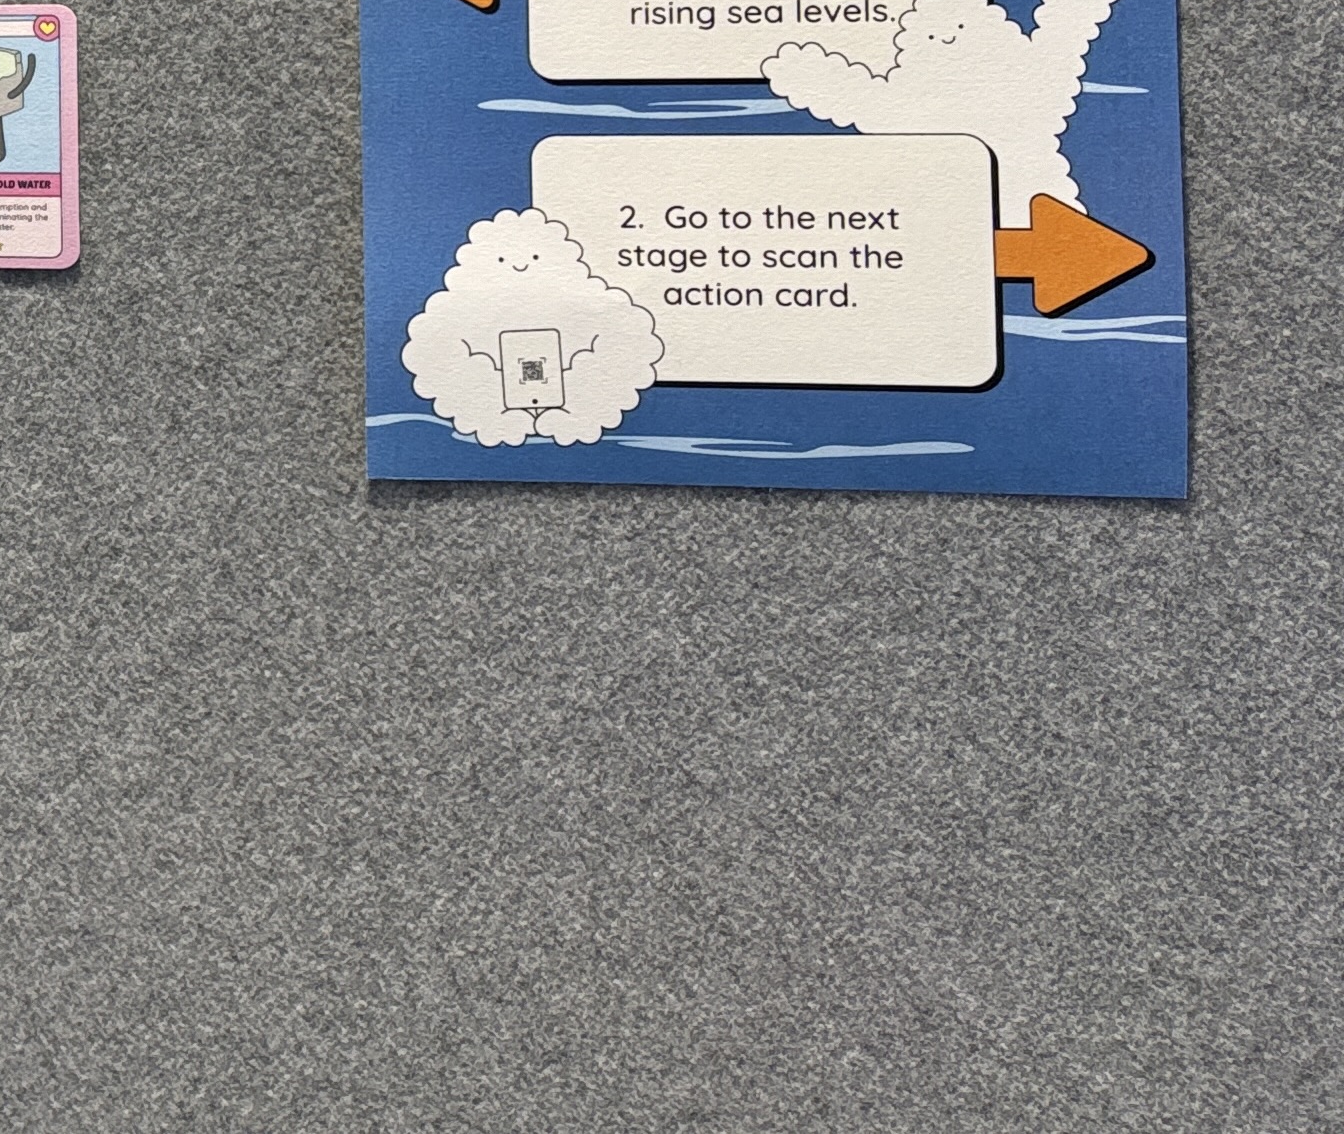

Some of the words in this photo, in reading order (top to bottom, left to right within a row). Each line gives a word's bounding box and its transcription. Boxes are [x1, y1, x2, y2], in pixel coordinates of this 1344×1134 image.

[631, 2, 715, 29] rising
[728, 4, 783, 23] sea
[796, 0, 895, 22] levels.
[18, 180, 51, 189] WATER
[620, 205, 644, 229] 2.
[665, 206, 707, 229] Go
[719, 207, 751, 229] to
[763, 205, 815, 229] the
[828, 208, 899, 229] next
[618, 245, 707, 273] stage
[718, 245, 751, 267] to
[763, 249, 837, 268] scan
[849, 244, 903, 269] the
[664, 283, 762, 306] action
[775, 283, 857, 307] card.
